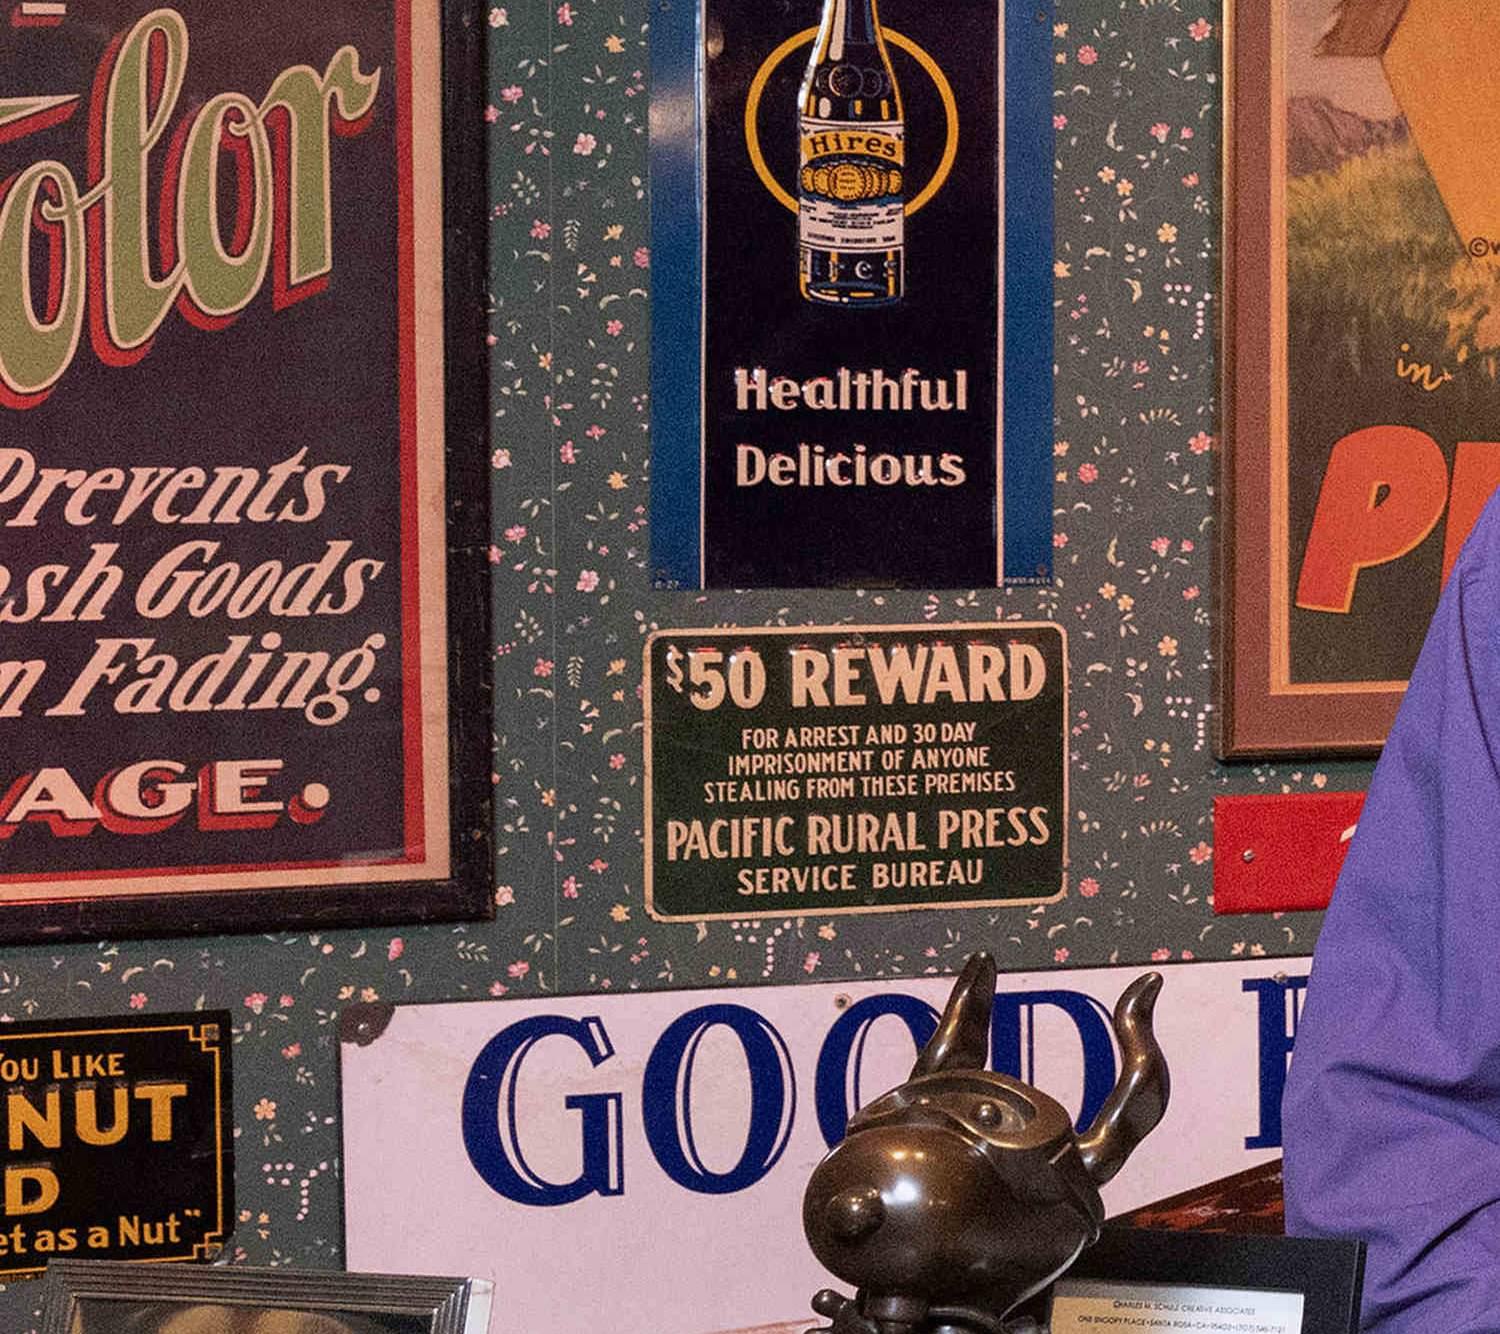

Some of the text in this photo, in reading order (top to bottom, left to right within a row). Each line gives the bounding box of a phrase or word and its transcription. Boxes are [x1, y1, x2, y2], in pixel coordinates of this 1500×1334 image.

[809, 136, 898, 158] Hires
[0, 8, 381, 396] olor
[1395, 341, 1448, 395] in
[733, 367, 969, 414] Healthful
[733, 444, 967, 489] Delicious
[0, 540, 388, 623] sh Goods
[47, 632, 388, 727] Fading.
[666, 641, 1047, 712] $50 REWARD
[742, 721, 978, 750] FOR ARREST AND 30 DAY
[728, 746, 991, 777] IMPRISONMENT OF ANYONE
[703, 770, 1016, 804] STEALING FROM THESE PREMISES
[666, 805, 1051, 862] PACIFIC RURAL PRESS
[737, 858, 984, 896] SERVICE BUREAU
[0, 1050, 125, 1082] OU LIKE
[7, 1083, 188, 1152] NUT
[33, 1226, 79, 1253] as
[87, 1224, 110, 1249] a
[1095, 1316, 1120, 1325] SNOOPY
[1215, 1306, 1256, 1315] ASSOCIATES
